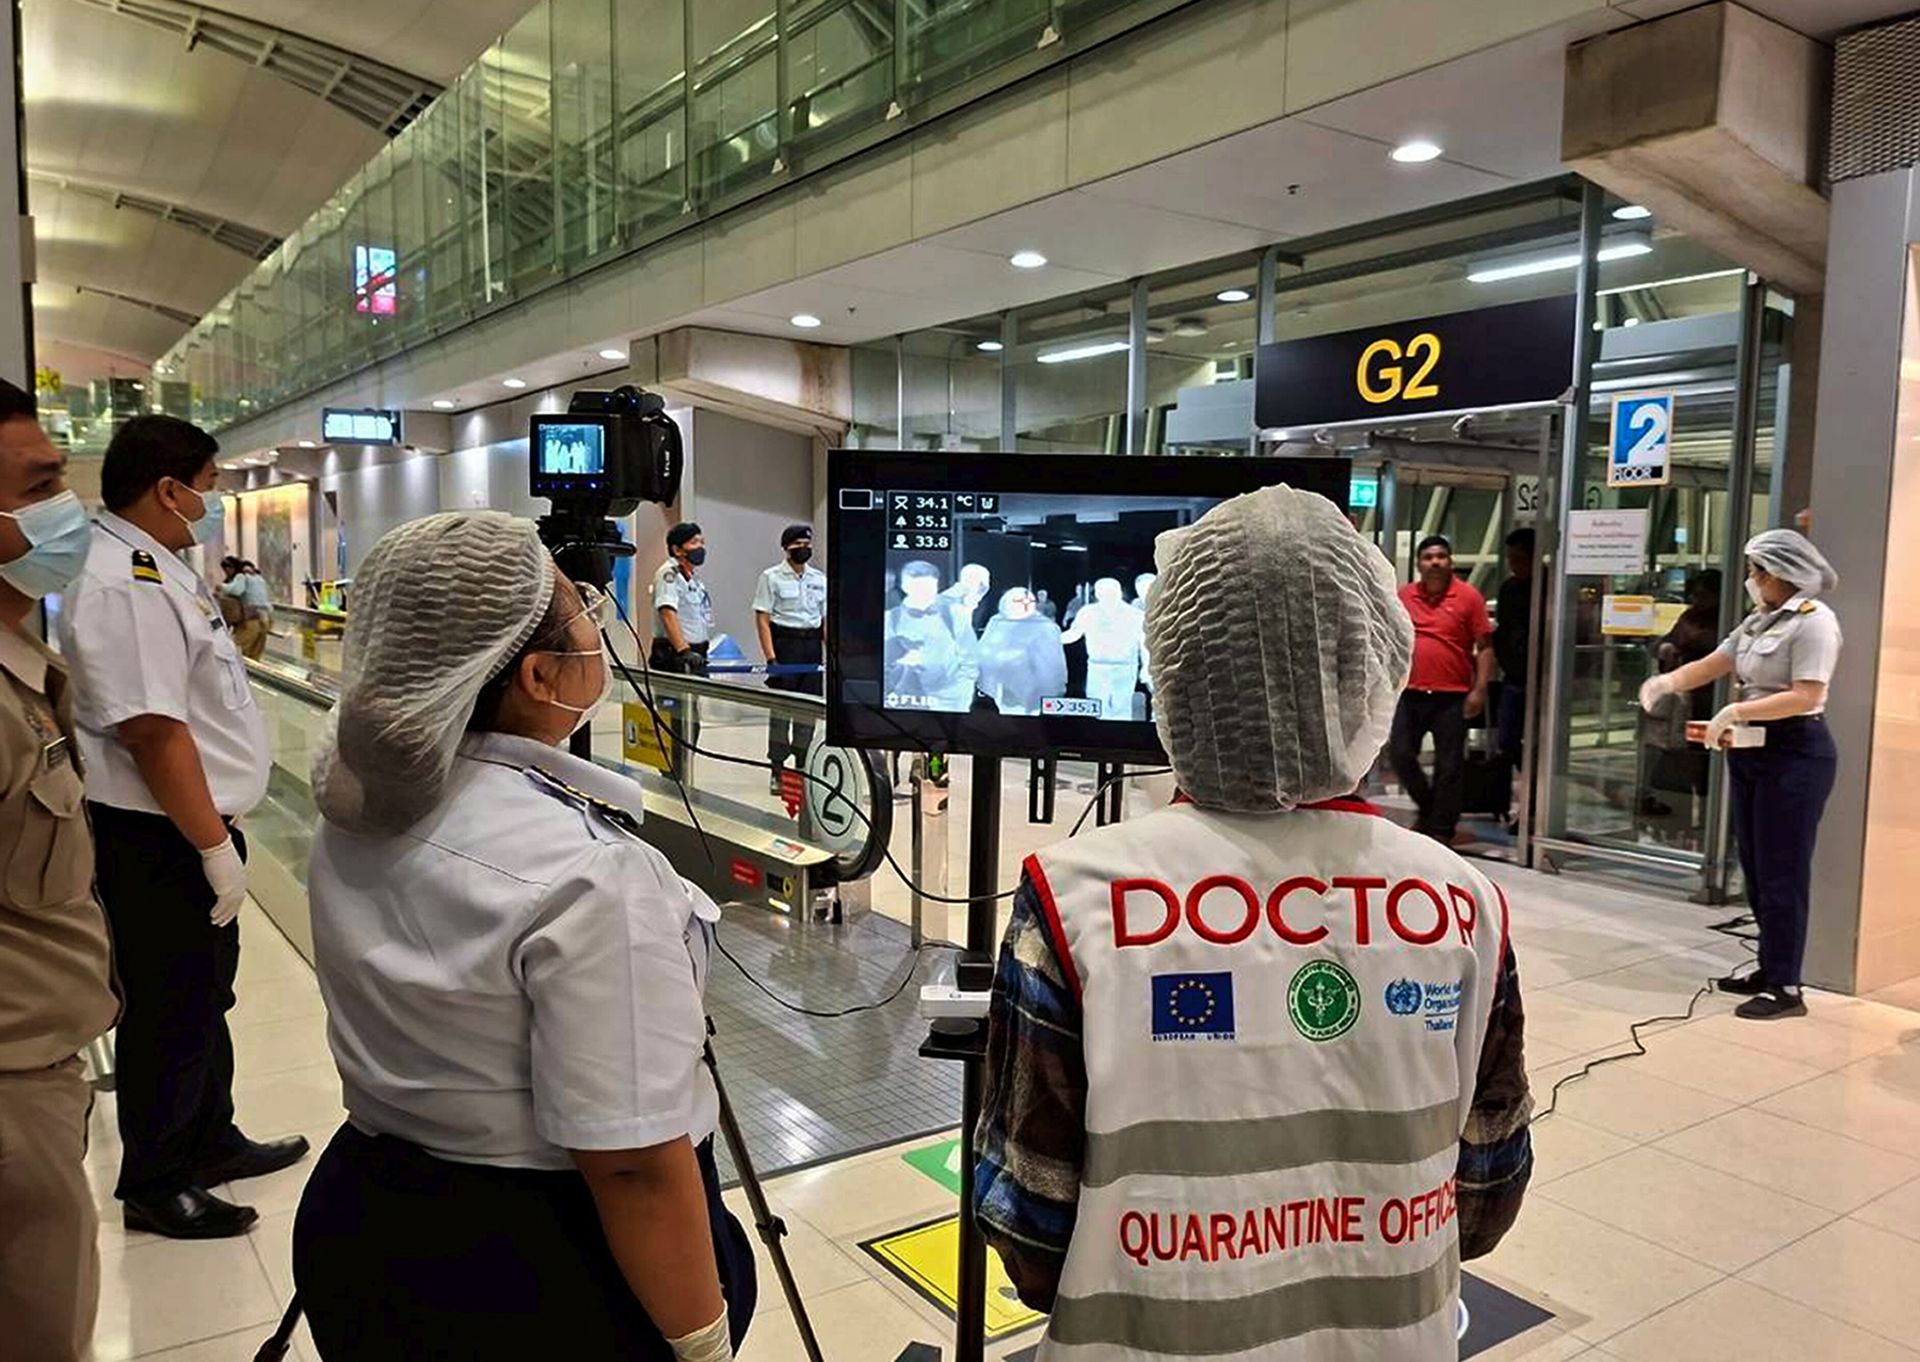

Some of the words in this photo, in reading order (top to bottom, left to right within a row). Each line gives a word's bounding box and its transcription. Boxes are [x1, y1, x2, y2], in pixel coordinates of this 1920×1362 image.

[1356, 333, 1441, 404] G2
[1629, 403, 1667, 468] 2
[915, 515, 948, 528] 35.1
[916, 497, 948, 510] 34.1
[915, 536, 949, 548] 33.8
[1069, 702, 1099, 714] 35.1
[822, 755, 845, 825] 2
[1110, 875, 1479, 948] DOCTOR
[1120, 1197, 1366, 1266] QUARANTINE
